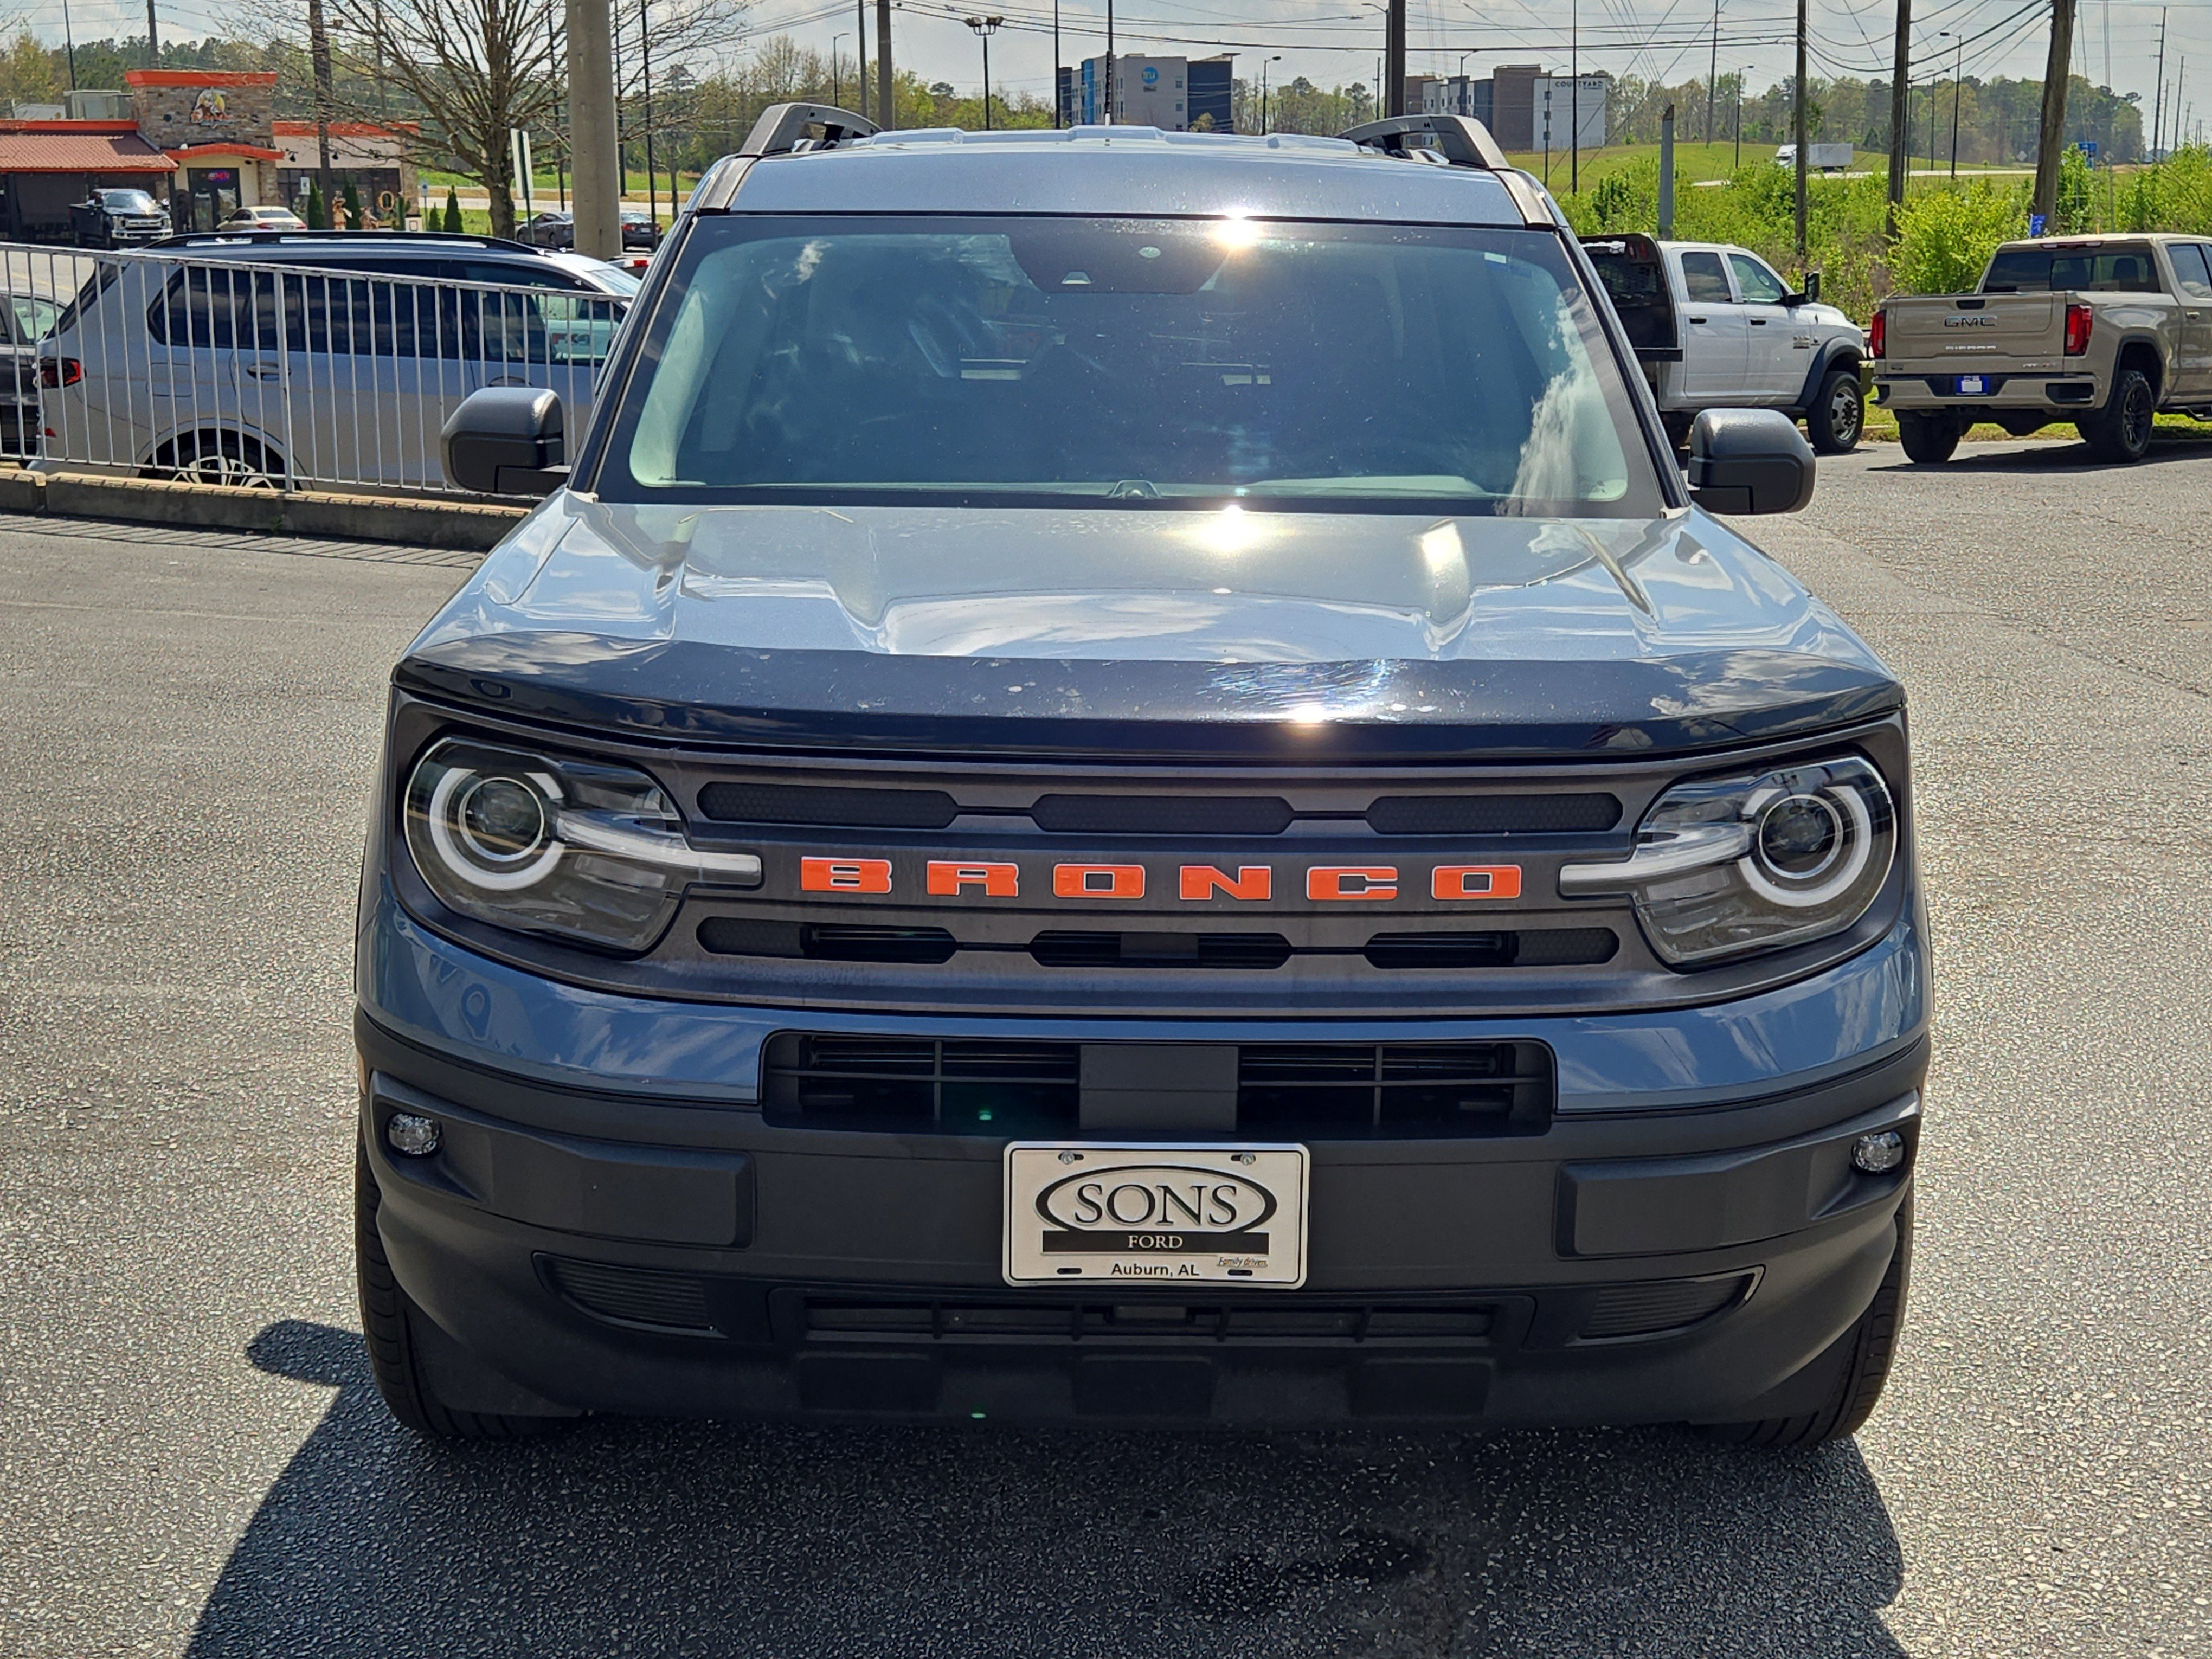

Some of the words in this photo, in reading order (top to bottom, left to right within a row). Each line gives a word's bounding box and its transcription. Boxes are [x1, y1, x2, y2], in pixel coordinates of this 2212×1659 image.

[1945, 316, 1997, 327] GMC
[801, 856, 1522, 900] BRONCO
[1075, 1184, 1237, 1225] SONS
[1128, 1235, 1183, 1248] FORD
[1111, 1263, 1173, 1277] Auburn,
[1178, 1264, 1200, 1276] AL
